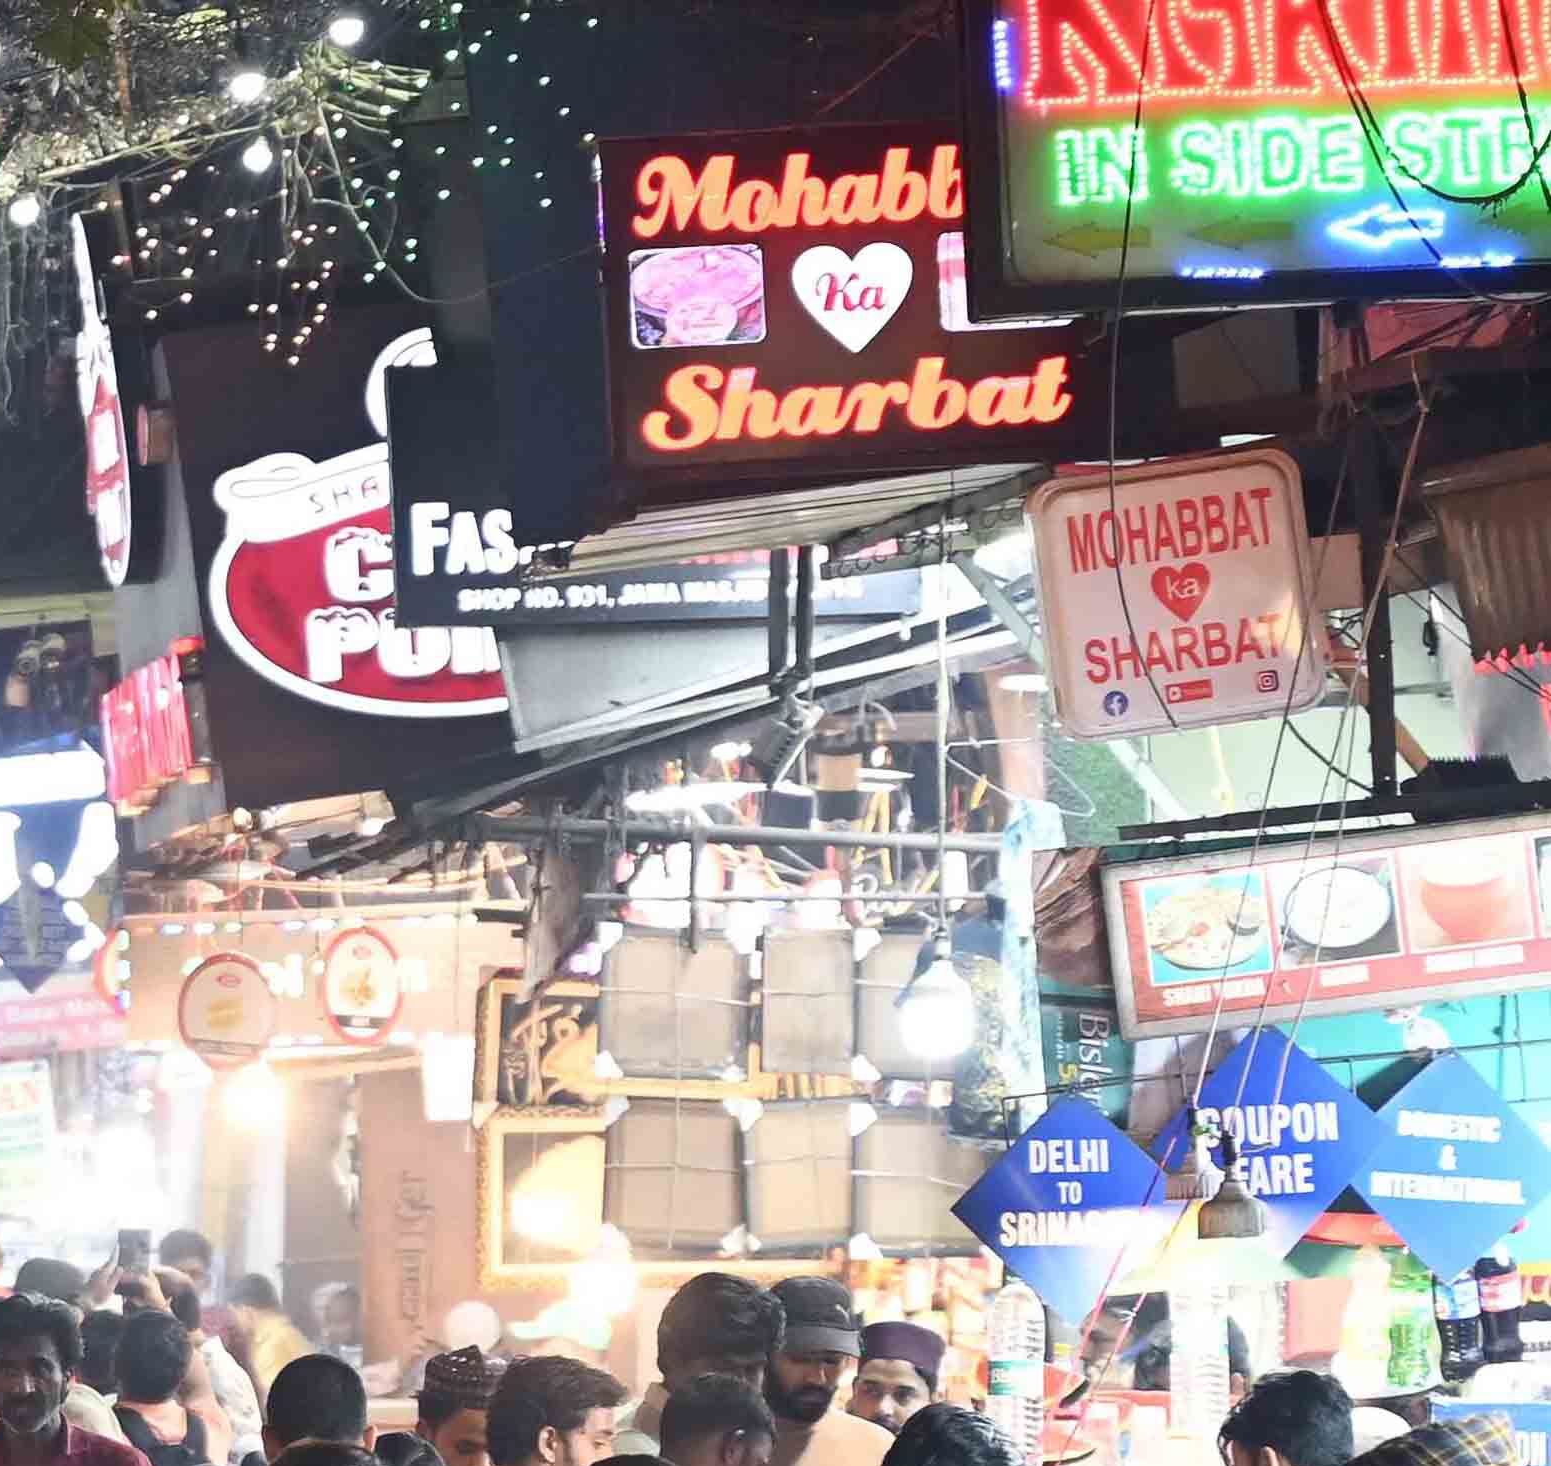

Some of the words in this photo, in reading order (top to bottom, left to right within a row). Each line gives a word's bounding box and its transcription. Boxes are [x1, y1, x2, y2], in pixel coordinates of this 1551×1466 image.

[1054, 126, 1149, 206] IN
[1170, 115, 1367, 197] SIDE
[1386, 107, 1551, 190] STR
[633, 145, 964, 238] Mohabb
[815, 272, 886, 312] Ka
[643, 356, 1072, 452] Sharbat
[1067, 487, 1272, 574] MOHABBAT
[1165, 576, 1200, 600] ka
[1085, 612, 1279, 684] SHARBAT
[1195, 1101, 1339, 1147] COUPON
[1029, 1138, 1110, 1174] DELHI
[1056, 1180, 1083, 1204] TO
